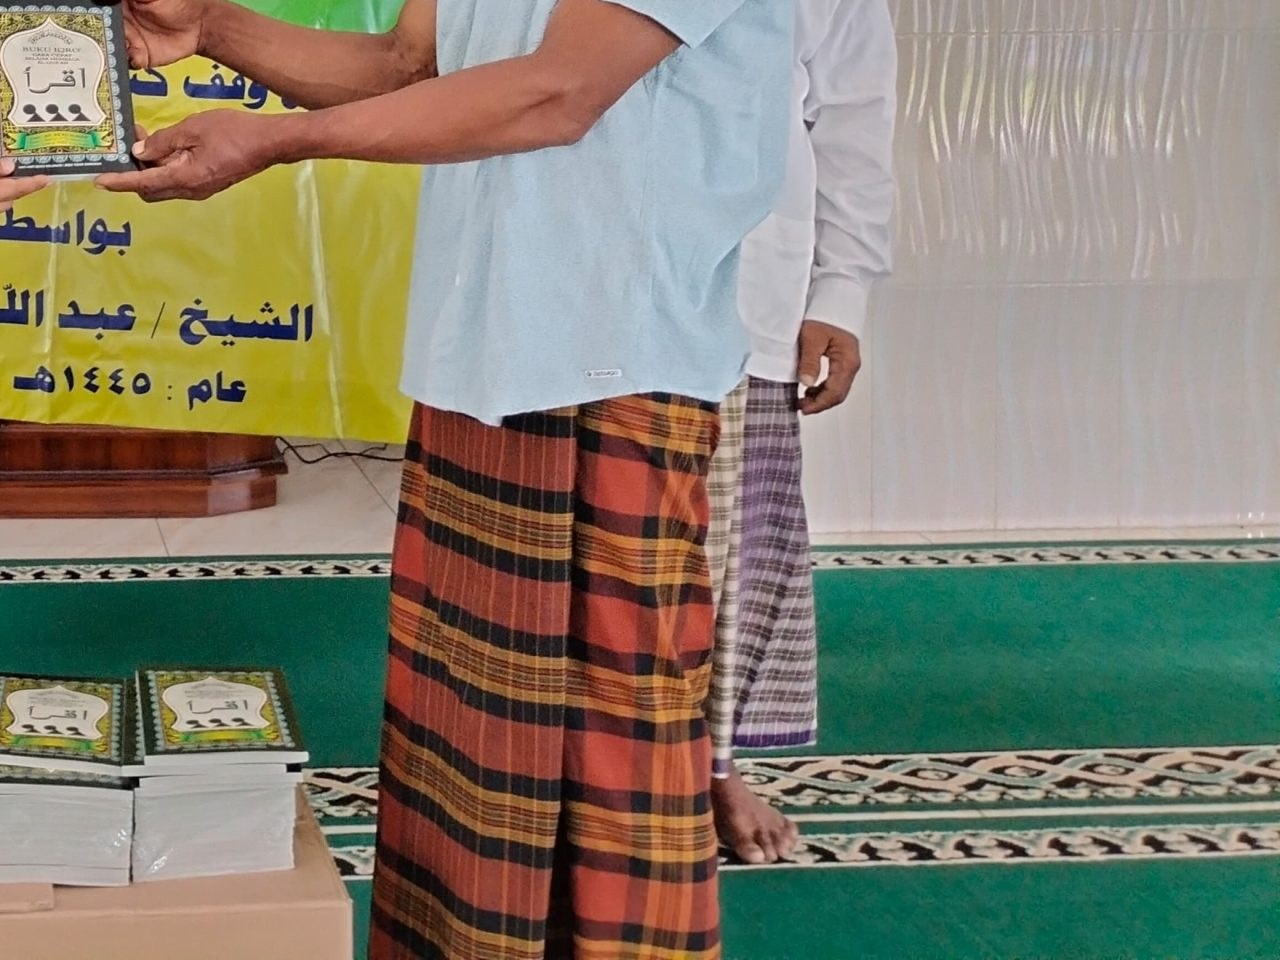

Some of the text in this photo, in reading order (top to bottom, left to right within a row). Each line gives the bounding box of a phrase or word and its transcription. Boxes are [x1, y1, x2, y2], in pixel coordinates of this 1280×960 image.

[58, 298, 137, 340] عبد
[179, 298, 314, 347] الشيخ
[187, 371, 247, 410] عام
